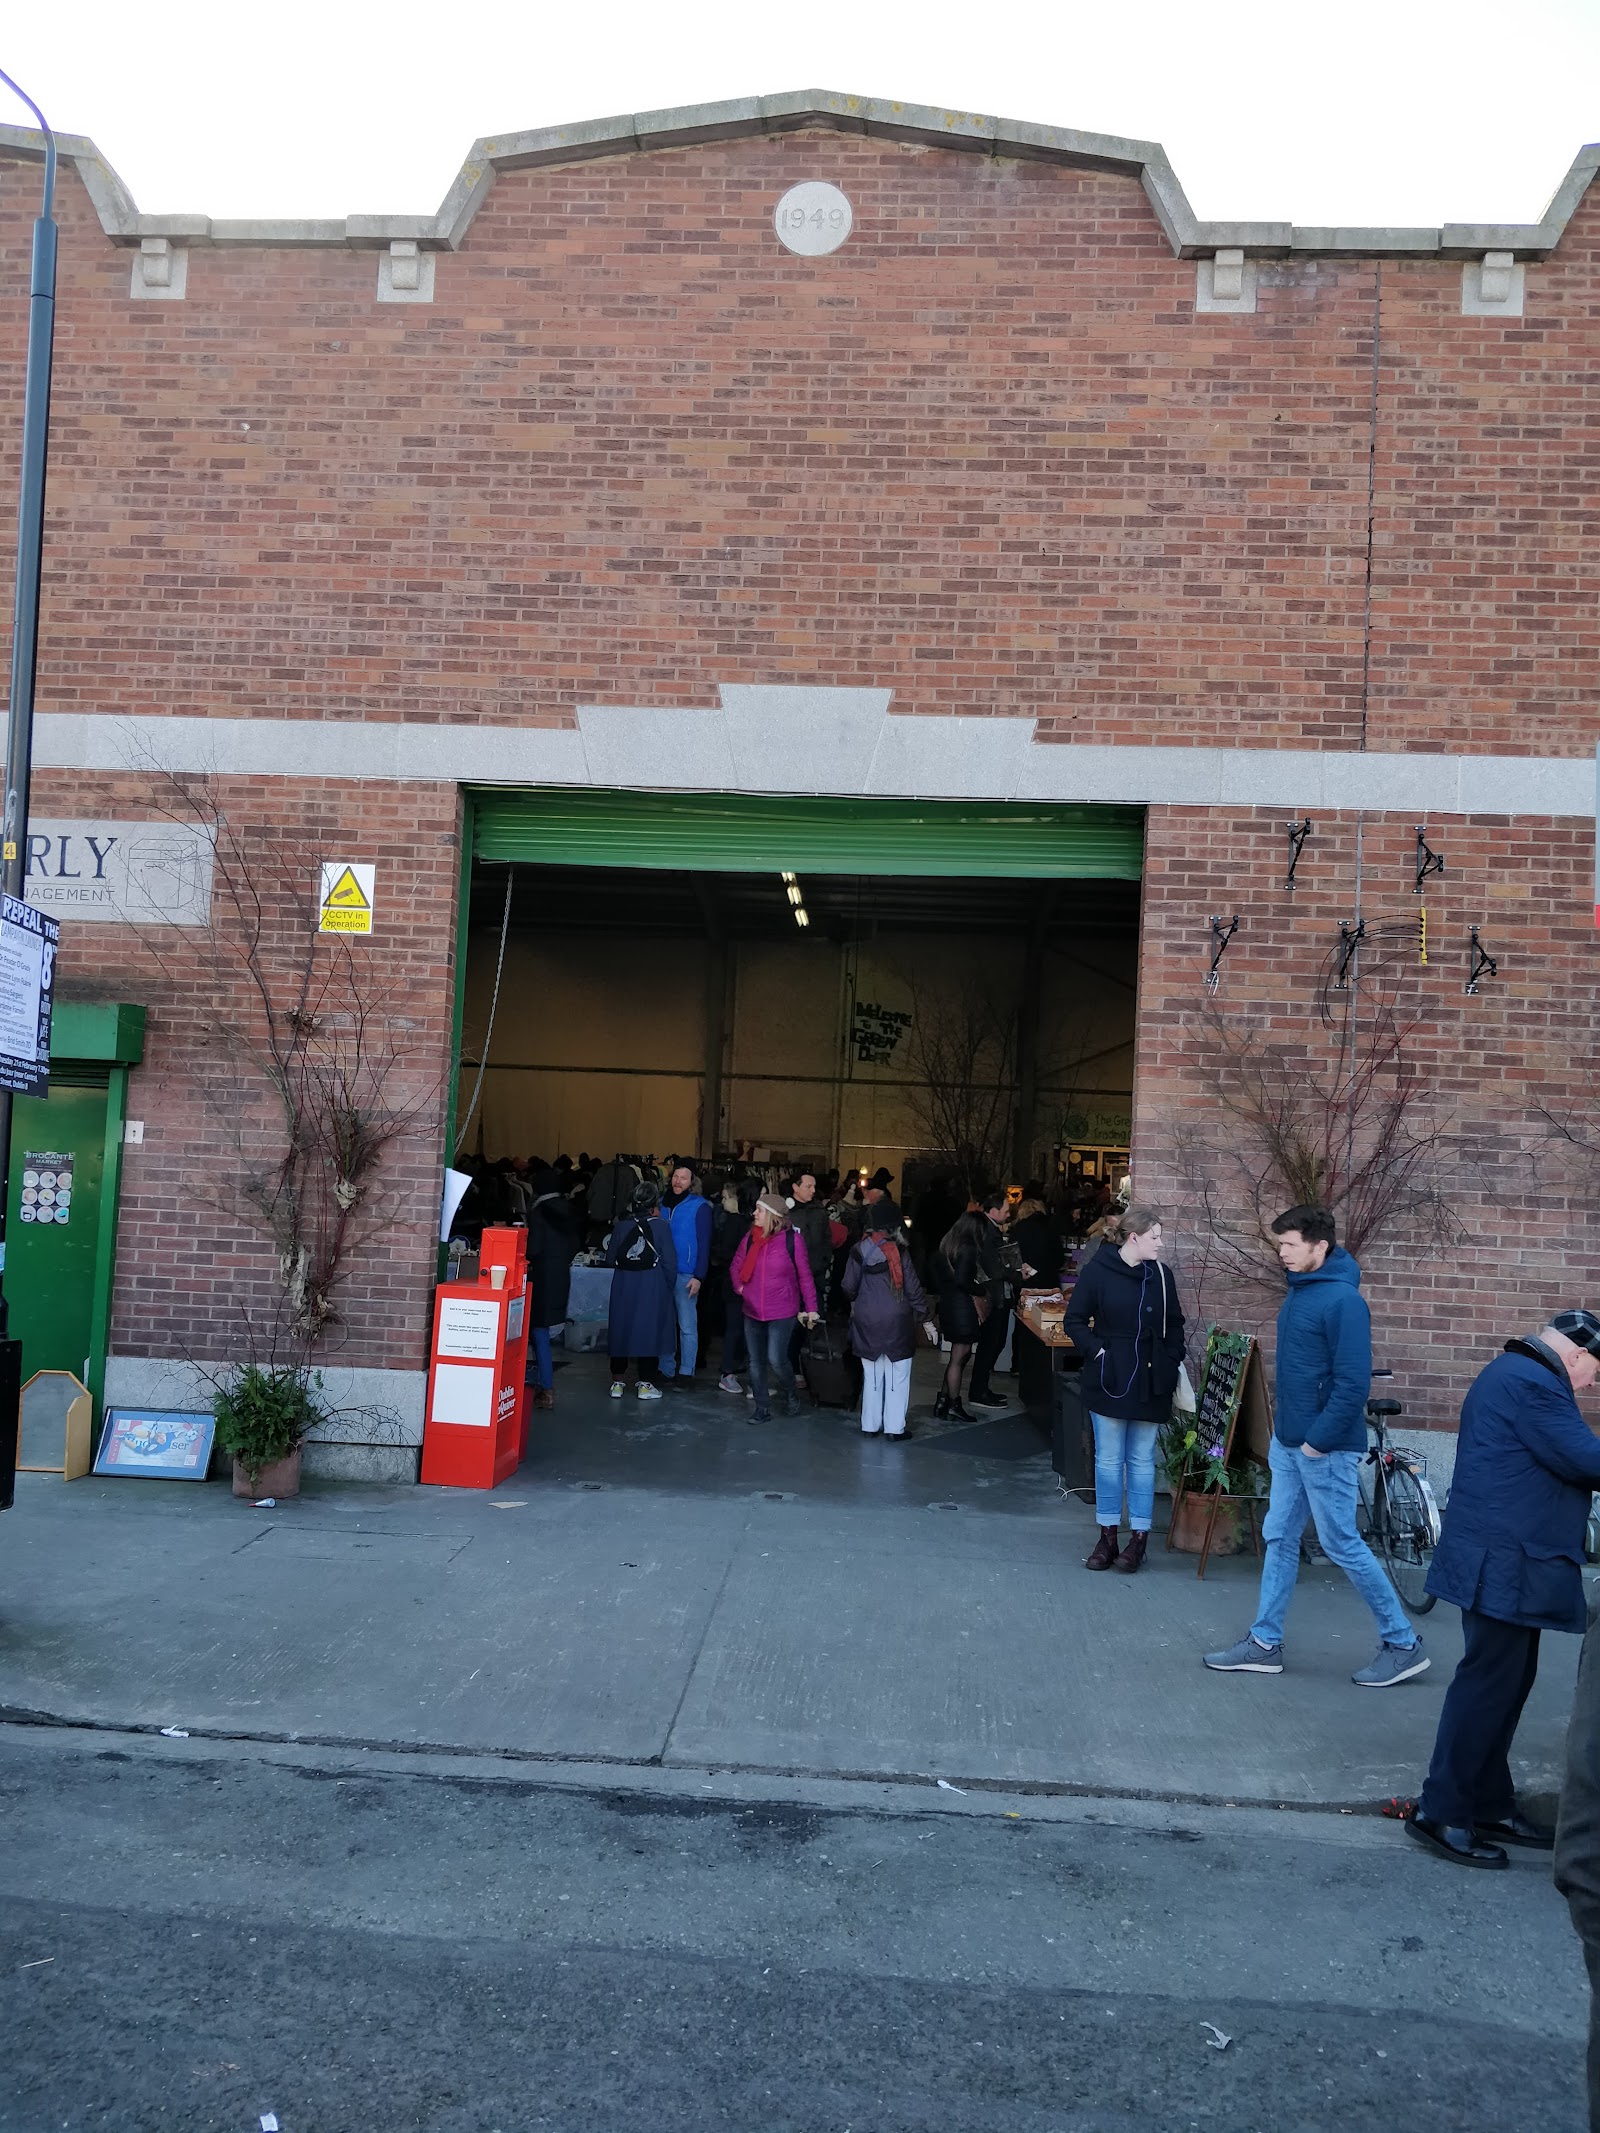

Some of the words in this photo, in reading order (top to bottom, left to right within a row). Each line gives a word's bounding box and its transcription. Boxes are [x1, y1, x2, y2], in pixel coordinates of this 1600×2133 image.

[781, 208, 845, 231] 1949
[5, 844, 15, 858] 4
[24, 834, 119, 879] RLY
[23, 886, 116, 903] NAGEMENT
[3, 897, 42, 933] REPEAL
[44, 920, 60, 941] THE
[329, 911, 353, 919] CCTV
[325, 921, 366, 929] operation
[25, 1151, 75, 1161] BROCANTE
[35, 1158, 63, 1166] MARKET
